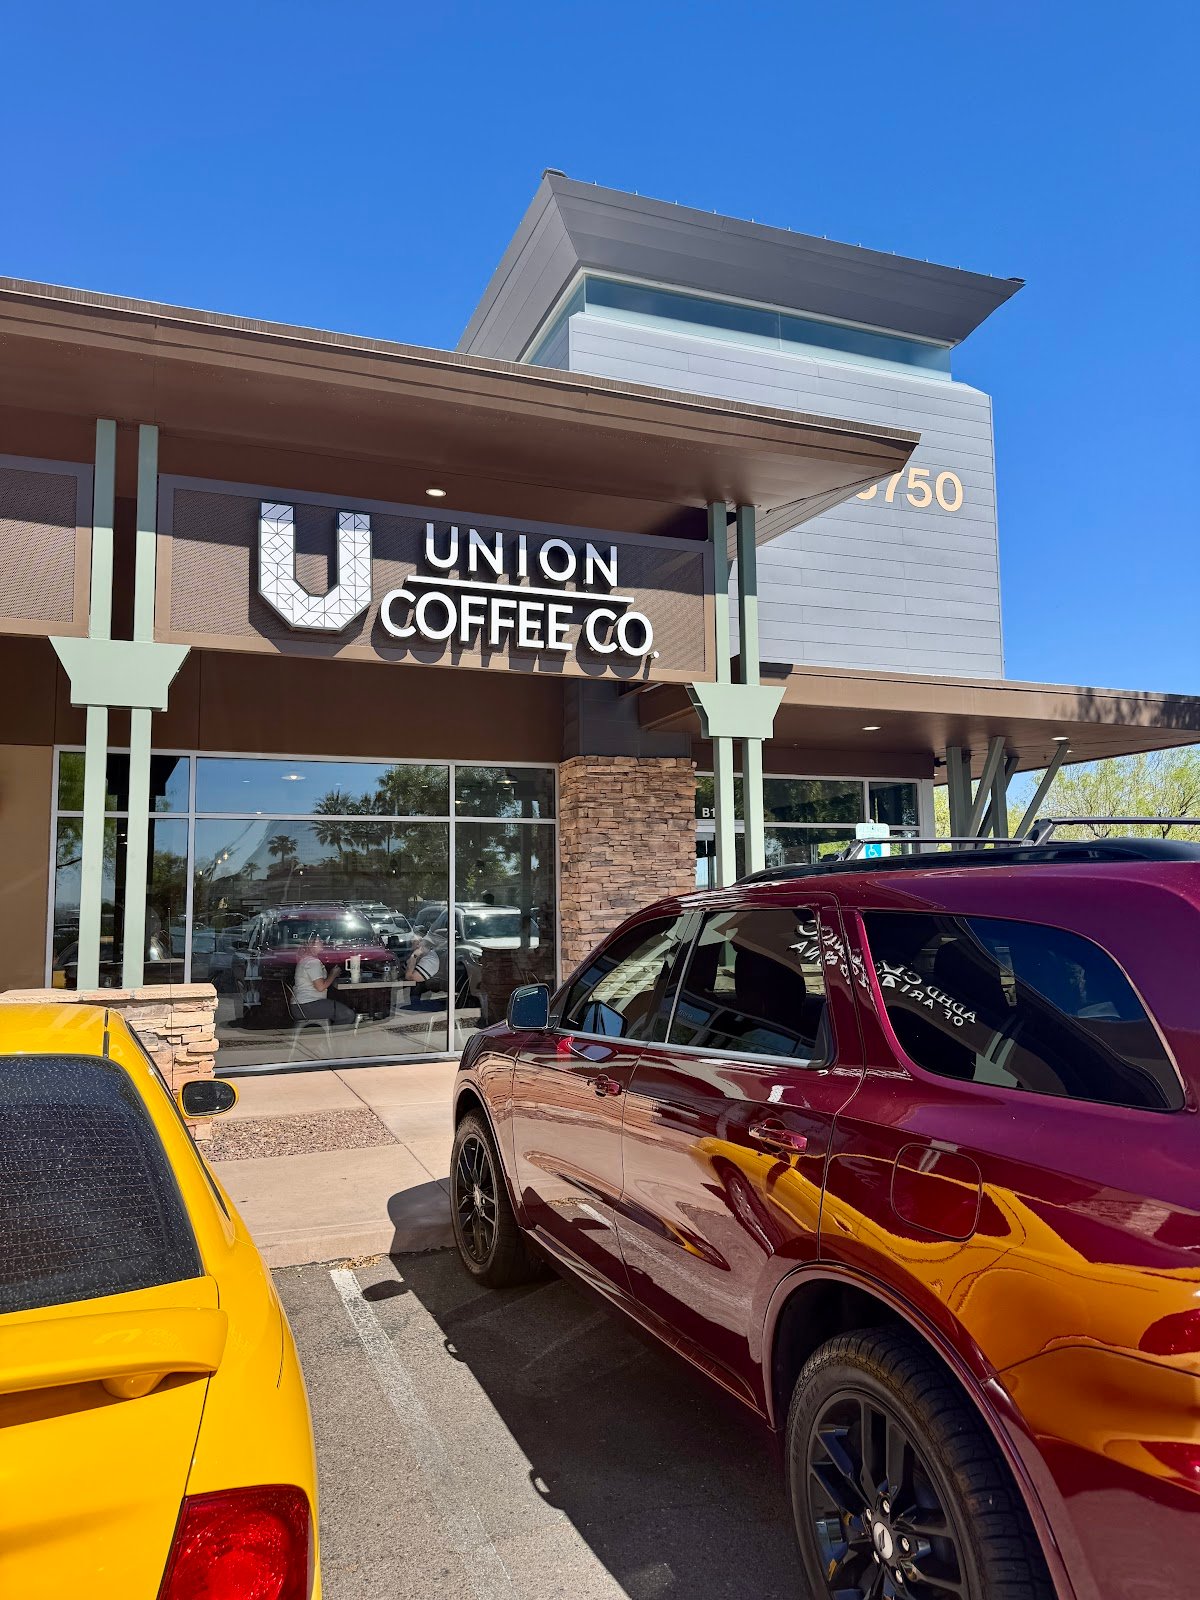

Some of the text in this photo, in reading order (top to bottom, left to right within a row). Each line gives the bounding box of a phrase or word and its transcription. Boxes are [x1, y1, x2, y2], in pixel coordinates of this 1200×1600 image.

[258, 501, 373, 632] U
[424, 522, 619, 588] UNION
[380, 588, 660, 660] COFFEE CO.
